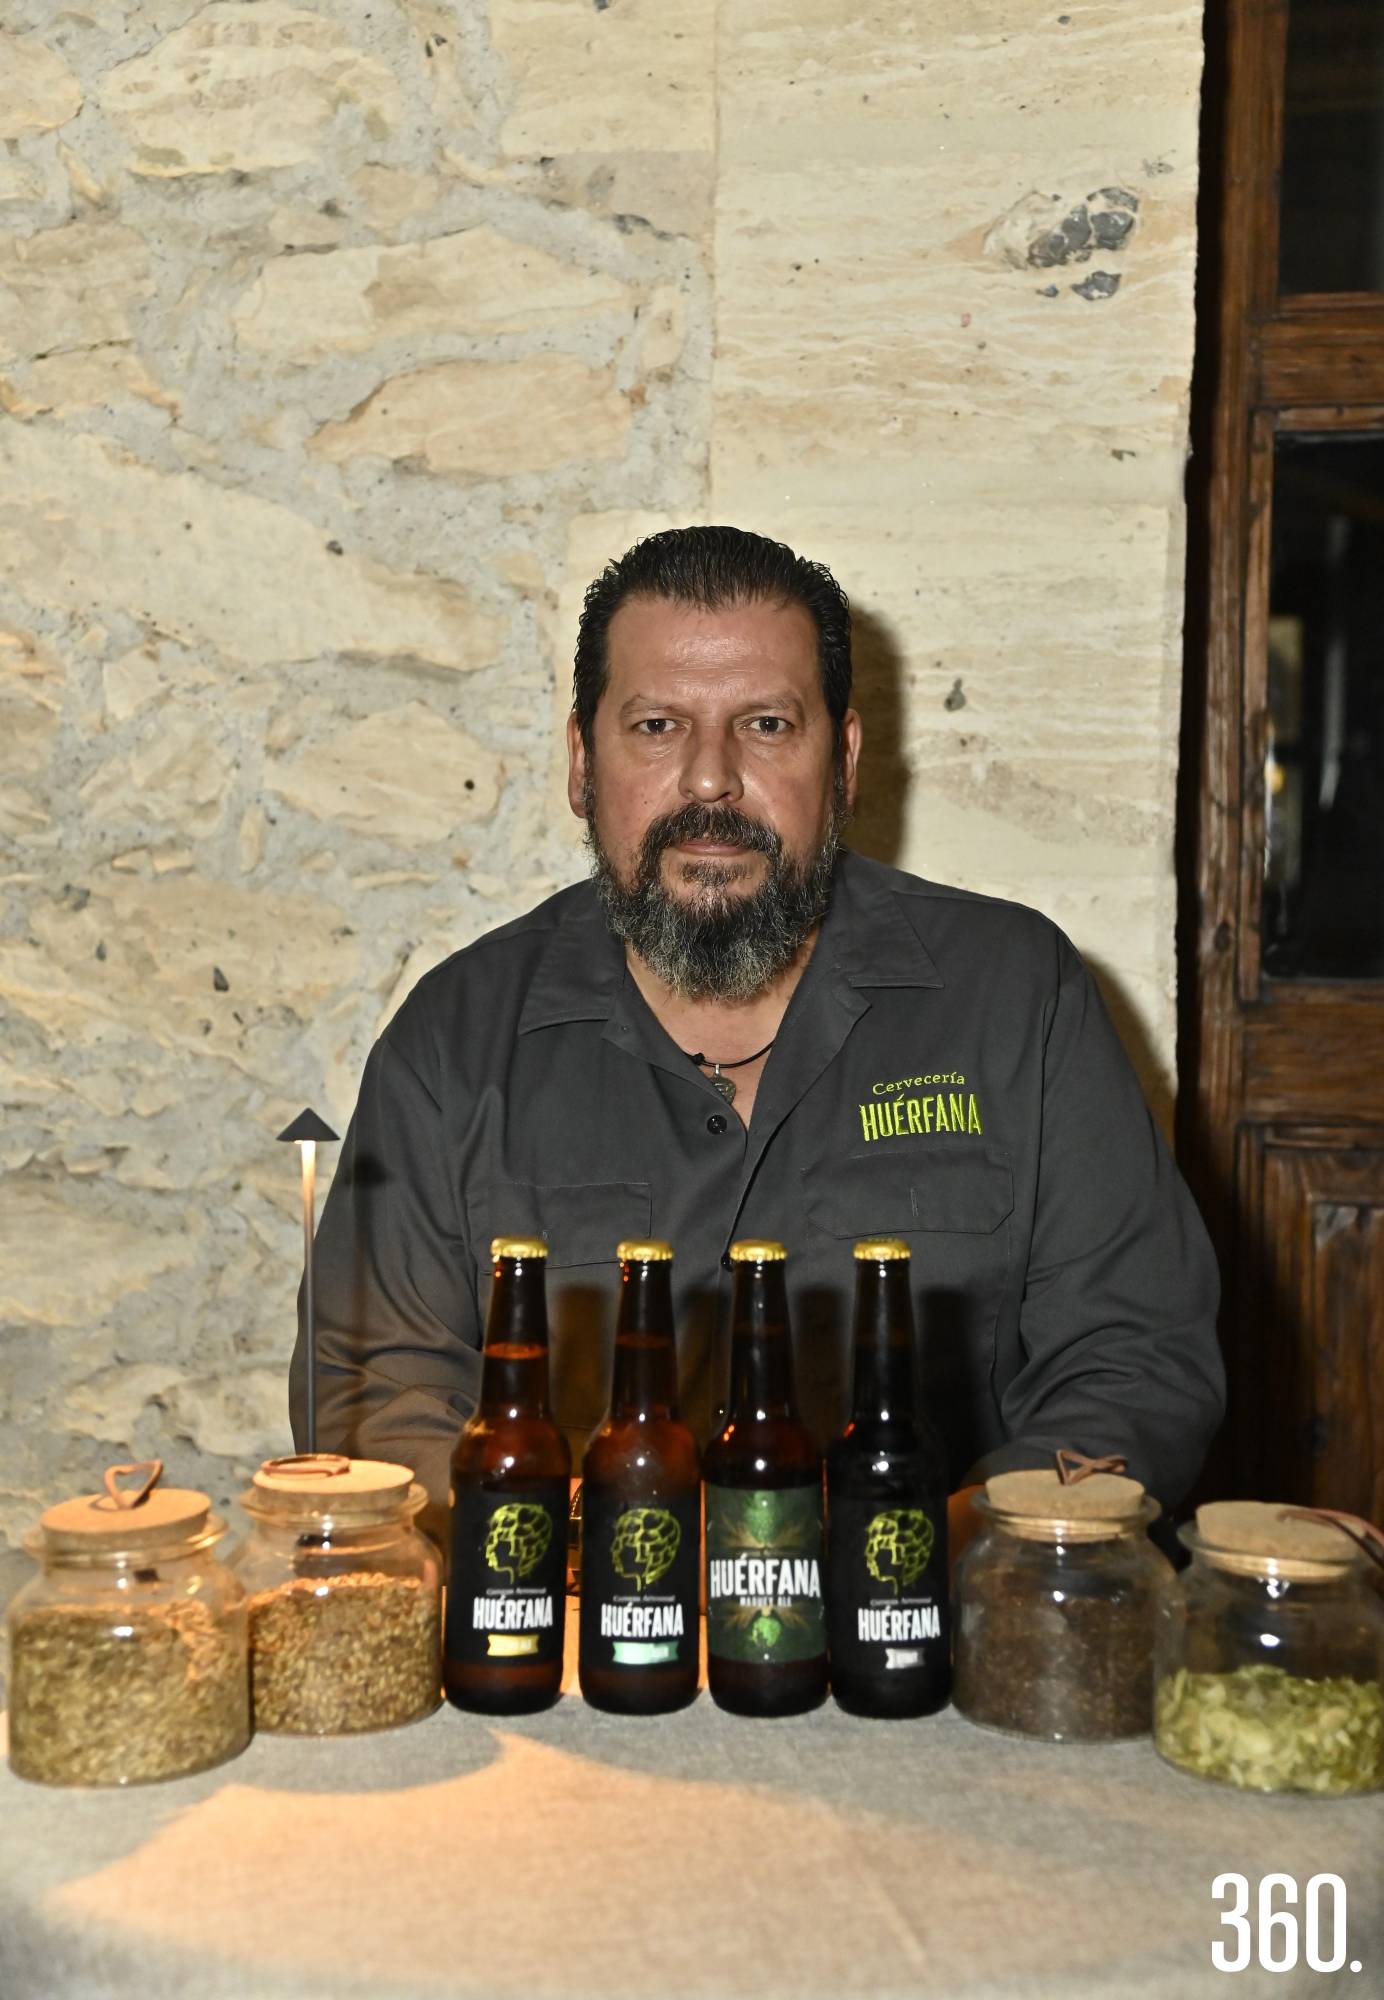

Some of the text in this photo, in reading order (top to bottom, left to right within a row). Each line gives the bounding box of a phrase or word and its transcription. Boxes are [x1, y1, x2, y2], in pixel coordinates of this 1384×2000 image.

[872, 1072, 965, 1095] Cervecería
[859, 1094, 983, 1141] HUÉRFANA
[710, 1553, 821, 1599] HUÉRFANA
[472, 1594, 553, 1630] HUÉRFANA
[600, 1601, 685, 1638] HUÉRFANA
[857, 1605, 941, 1642] HUÉRFANA
